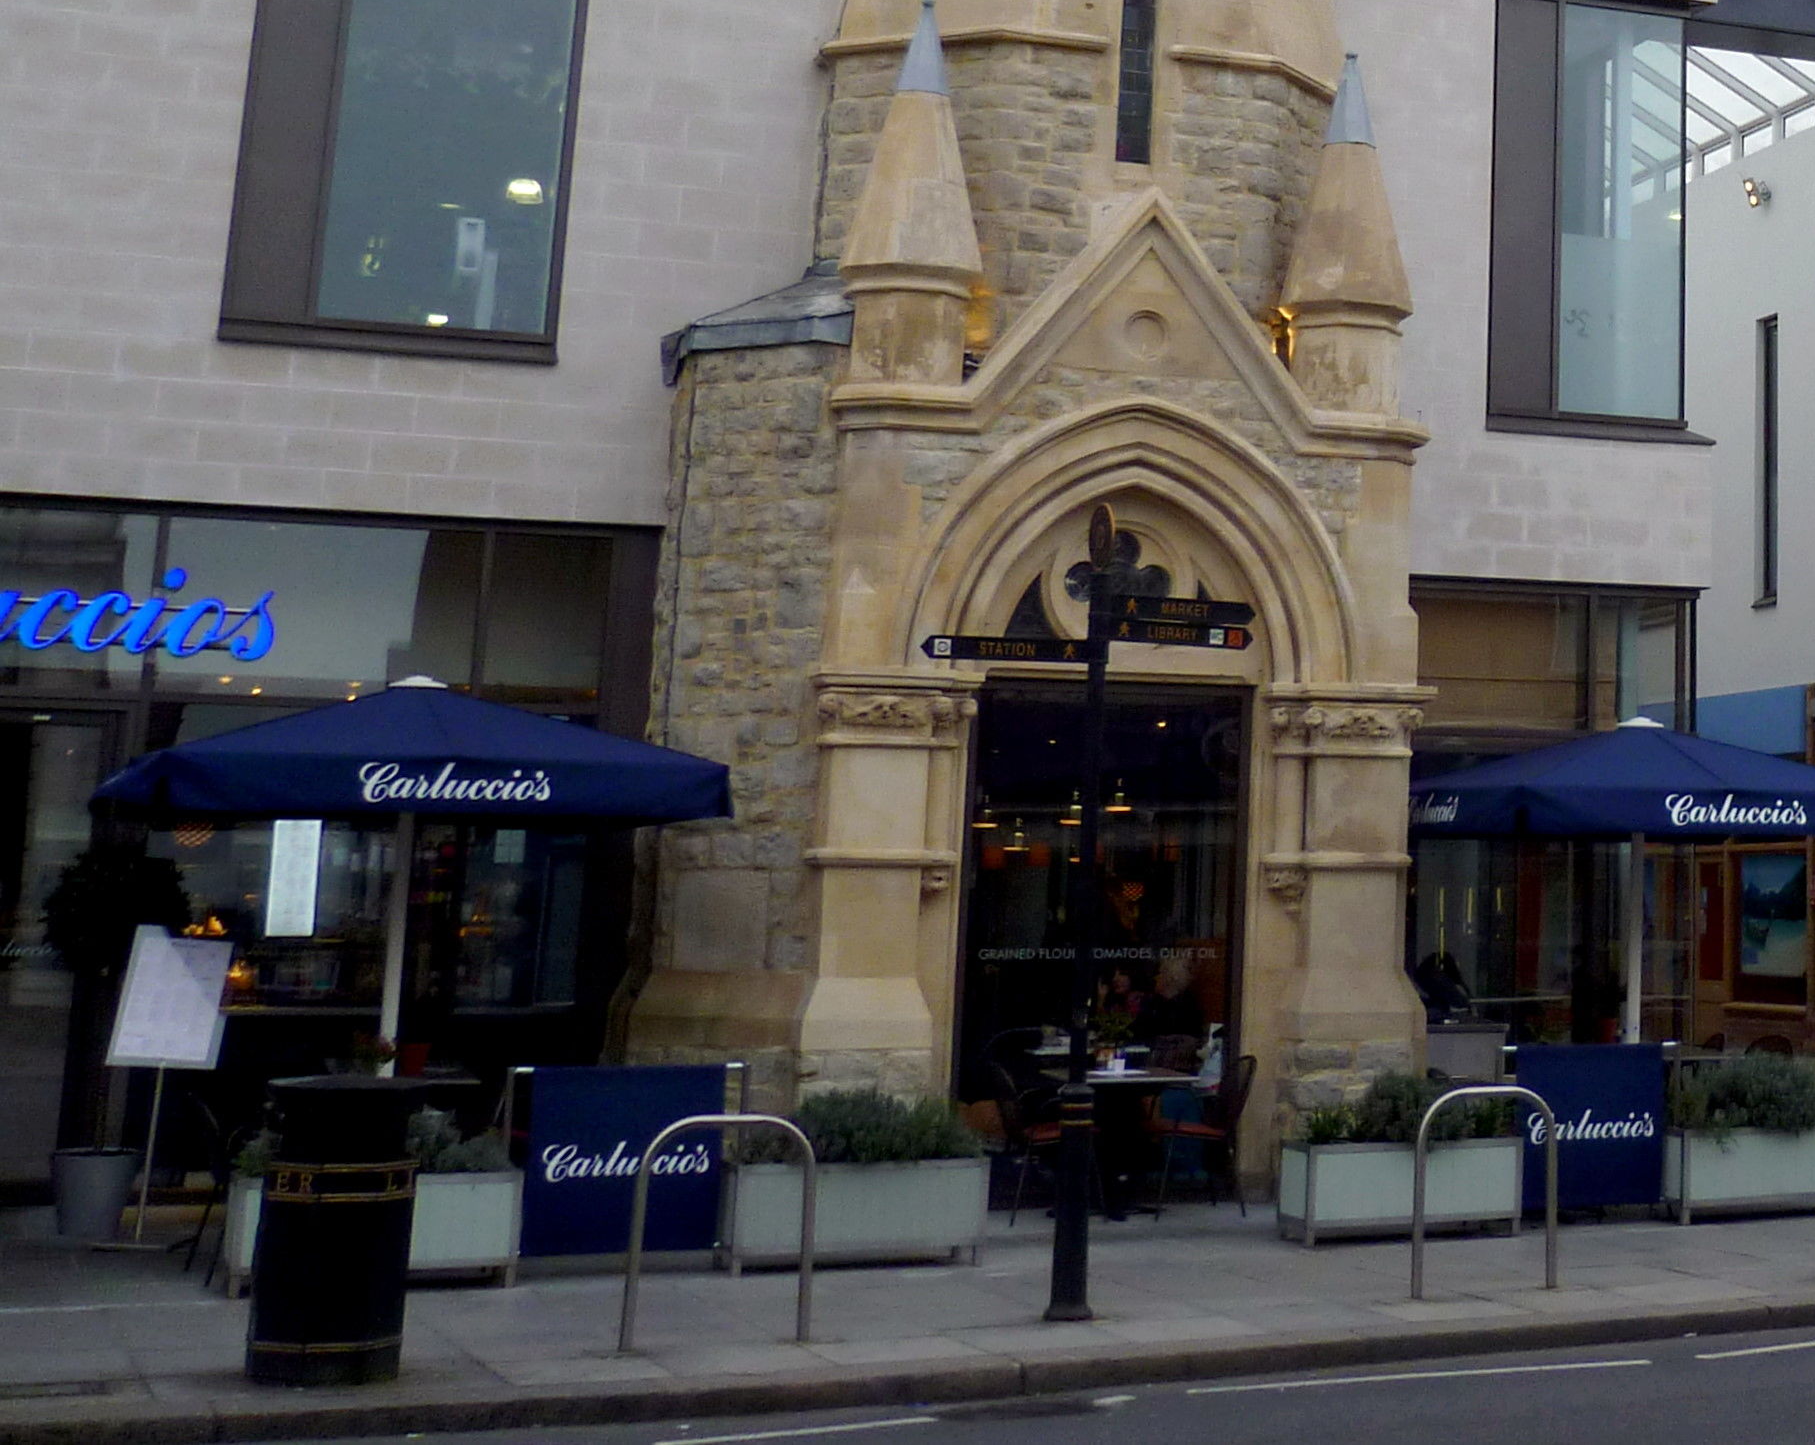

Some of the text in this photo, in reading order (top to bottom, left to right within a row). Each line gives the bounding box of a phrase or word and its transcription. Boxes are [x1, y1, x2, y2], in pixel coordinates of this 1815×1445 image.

[1161, 602, 1212, 618] MARKET
[1147, 626, 1198, 642] LIBRARY
[978, 641, 1035, 657] STATION
[358, 761, 551, 803] Carluccio's
[1665, 793, 1808, 827] Carluccio's
[977, 947, 1036, 961] GRAINED
[1092, 947, 1157, 961] OMATOES,
[541, 1140, 711, 1183] Carlucio's
